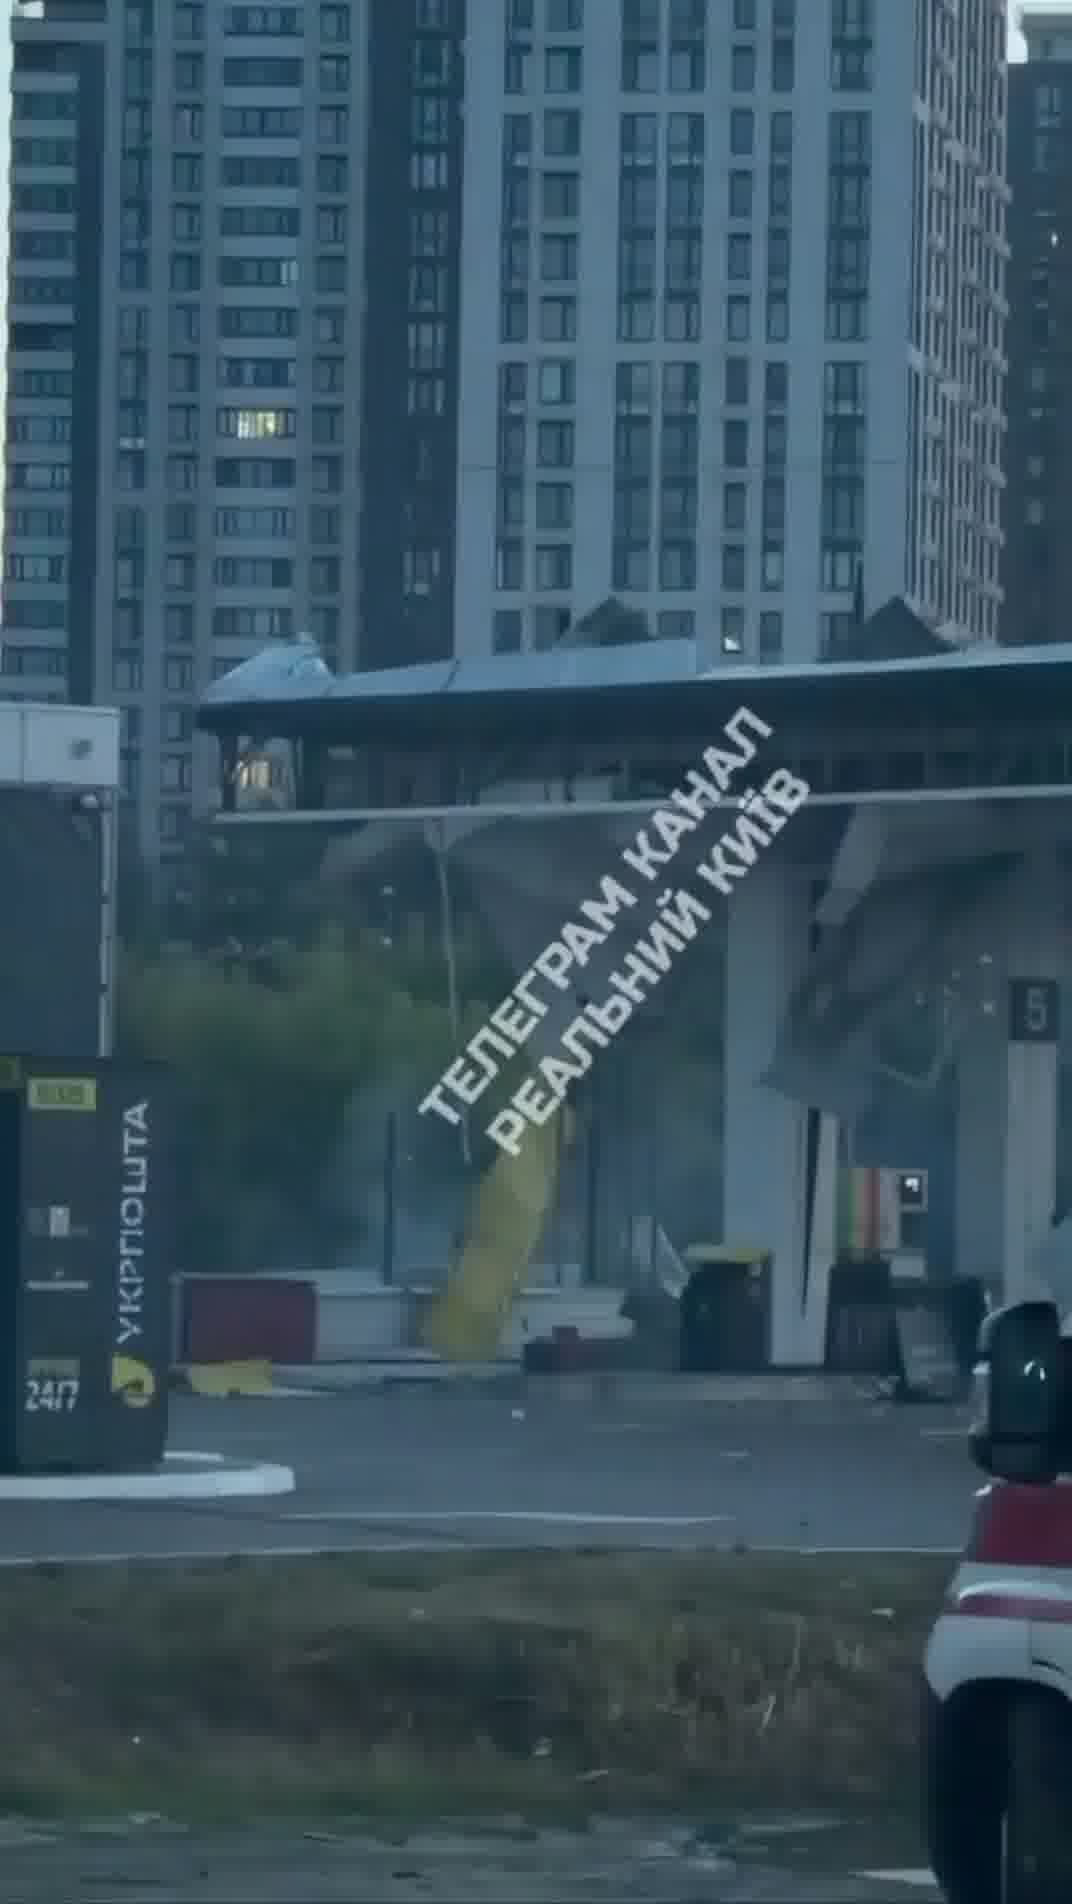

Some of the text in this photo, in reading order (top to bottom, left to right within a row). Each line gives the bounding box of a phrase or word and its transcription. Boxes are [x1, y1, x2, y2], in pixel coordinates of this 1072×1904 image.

[1025, 987, 1048, 1032] 5
[116, 1098, 149, 1344] УКРПОШТА
[24, 1379, 79, 1412] 24/7
